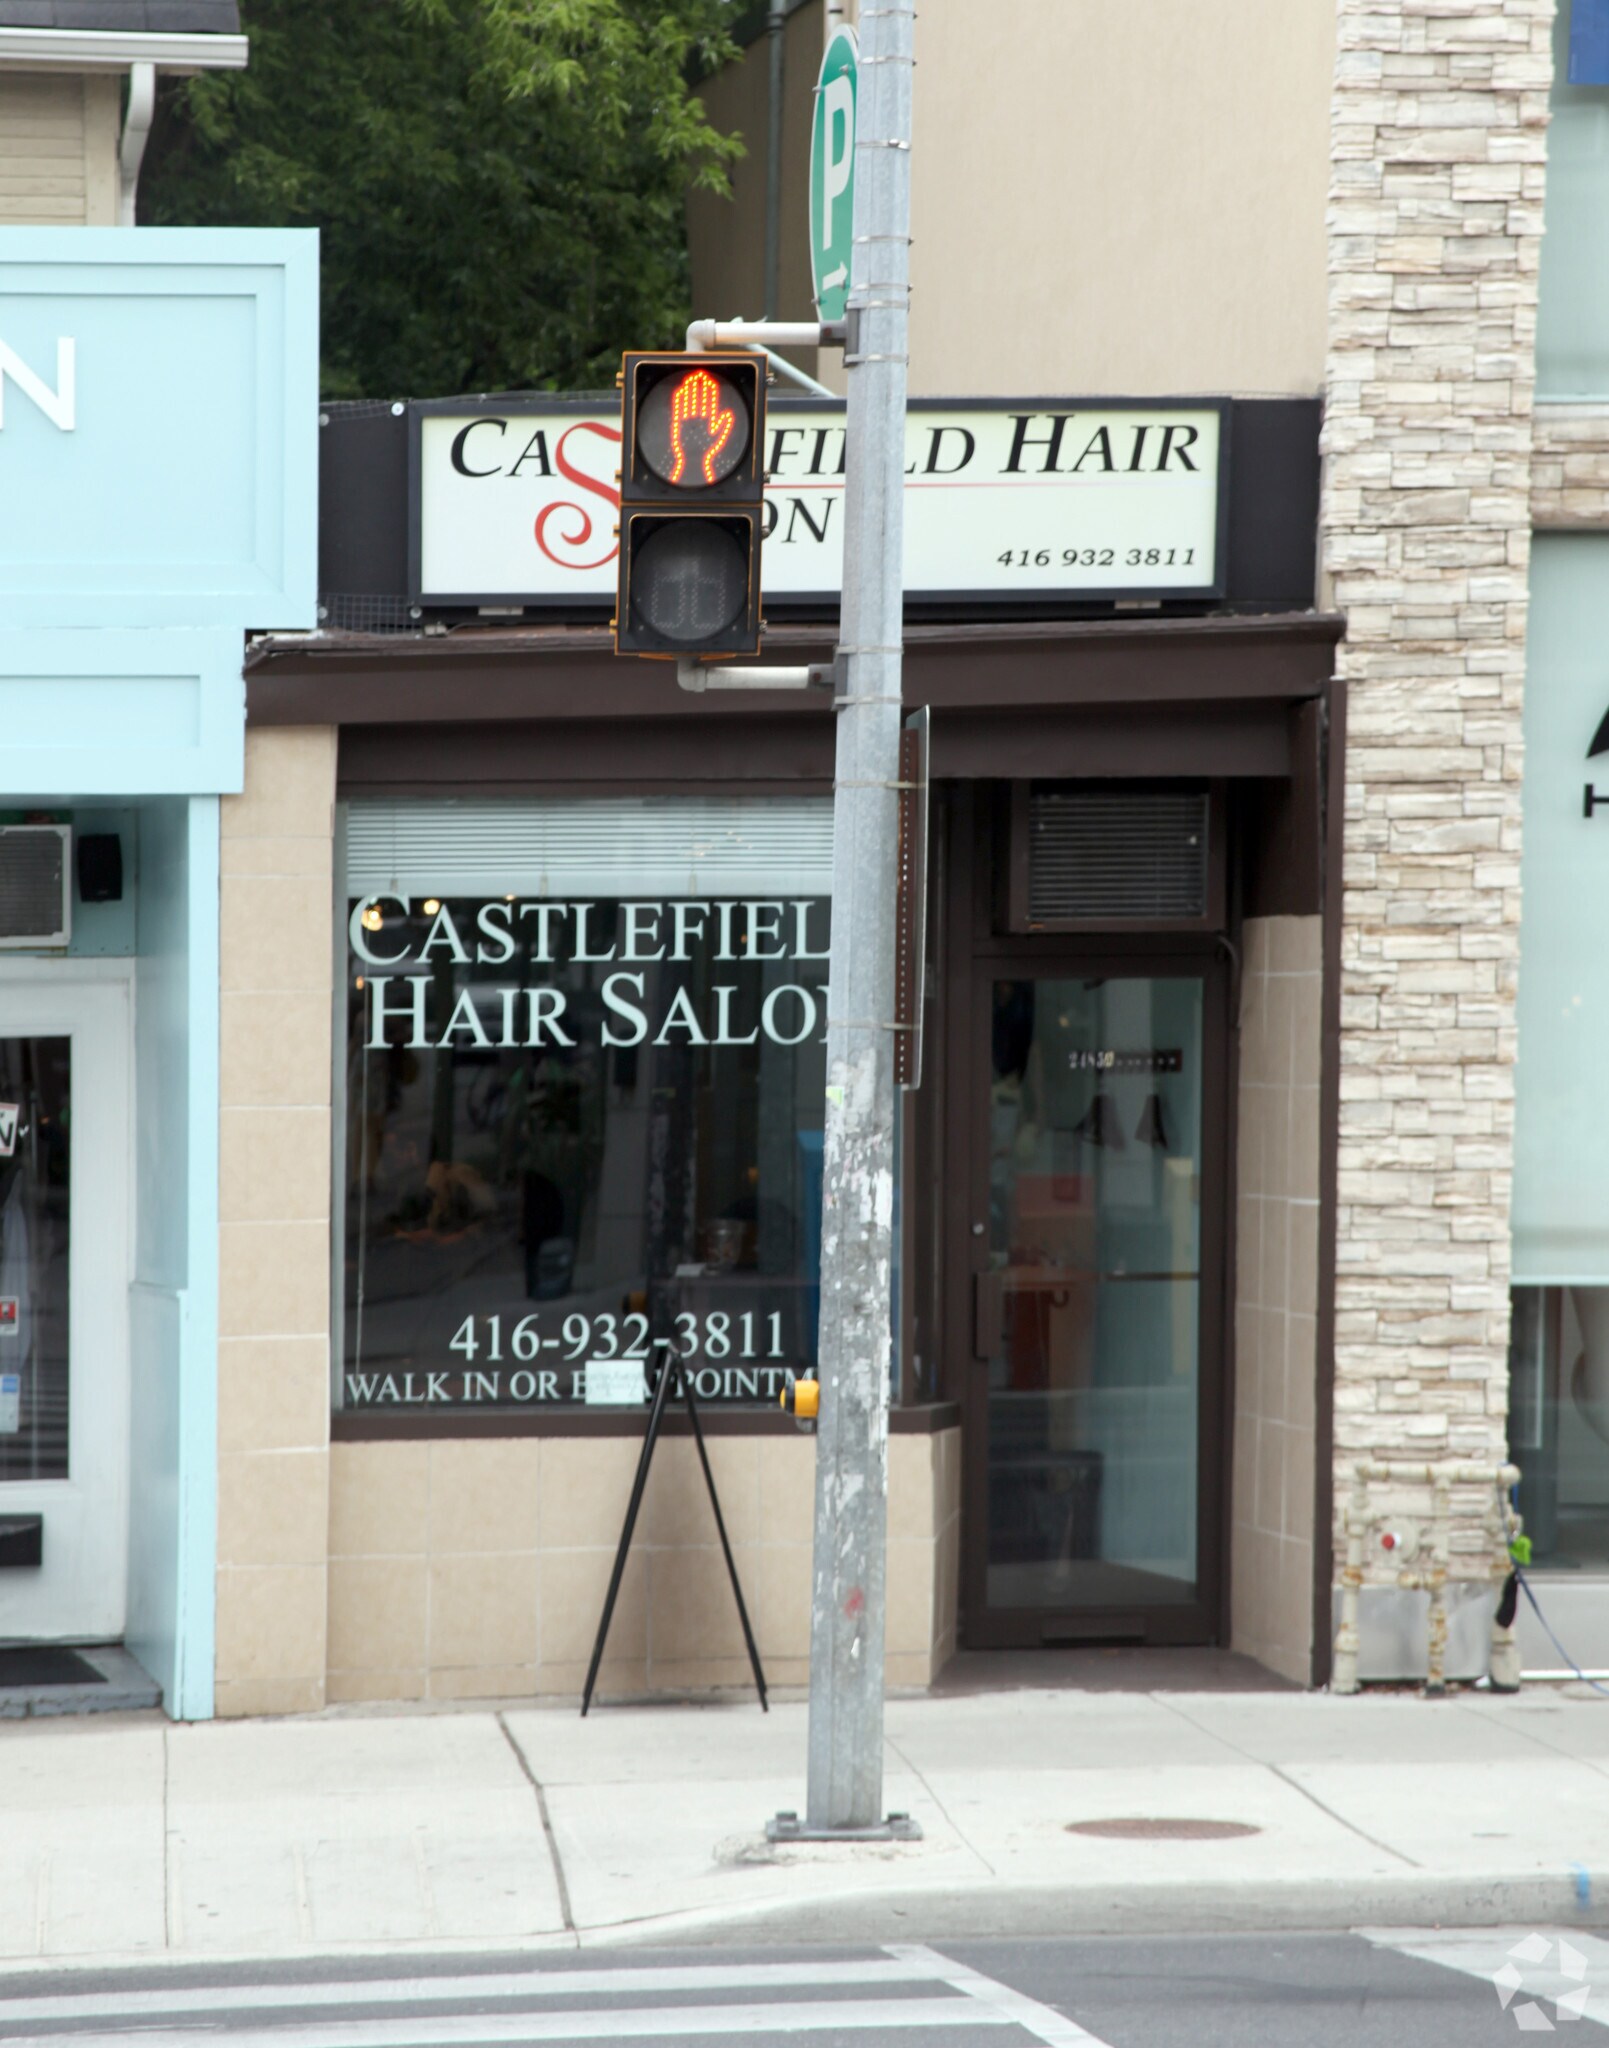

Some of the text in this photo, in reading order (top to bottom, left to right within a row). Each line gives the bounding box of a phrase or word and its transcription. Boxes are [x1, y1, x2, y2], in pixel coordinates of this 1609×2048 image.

[823, 75, 854, 251] P
[998, 415, 1200, 474] HAIR
[997, 548, 1195, 567] 416 932 3811
[349, 891, 831, 966] CASTLEFIEL
[363, 975, 577, 1049] HAIR
[449, 1311, 784, 1361] 416-932-3811
[346, 1371, 453, 1402] WALK
[463, 1370, 499, 1400] IN
[509, 1370, 561, 1401] OR
